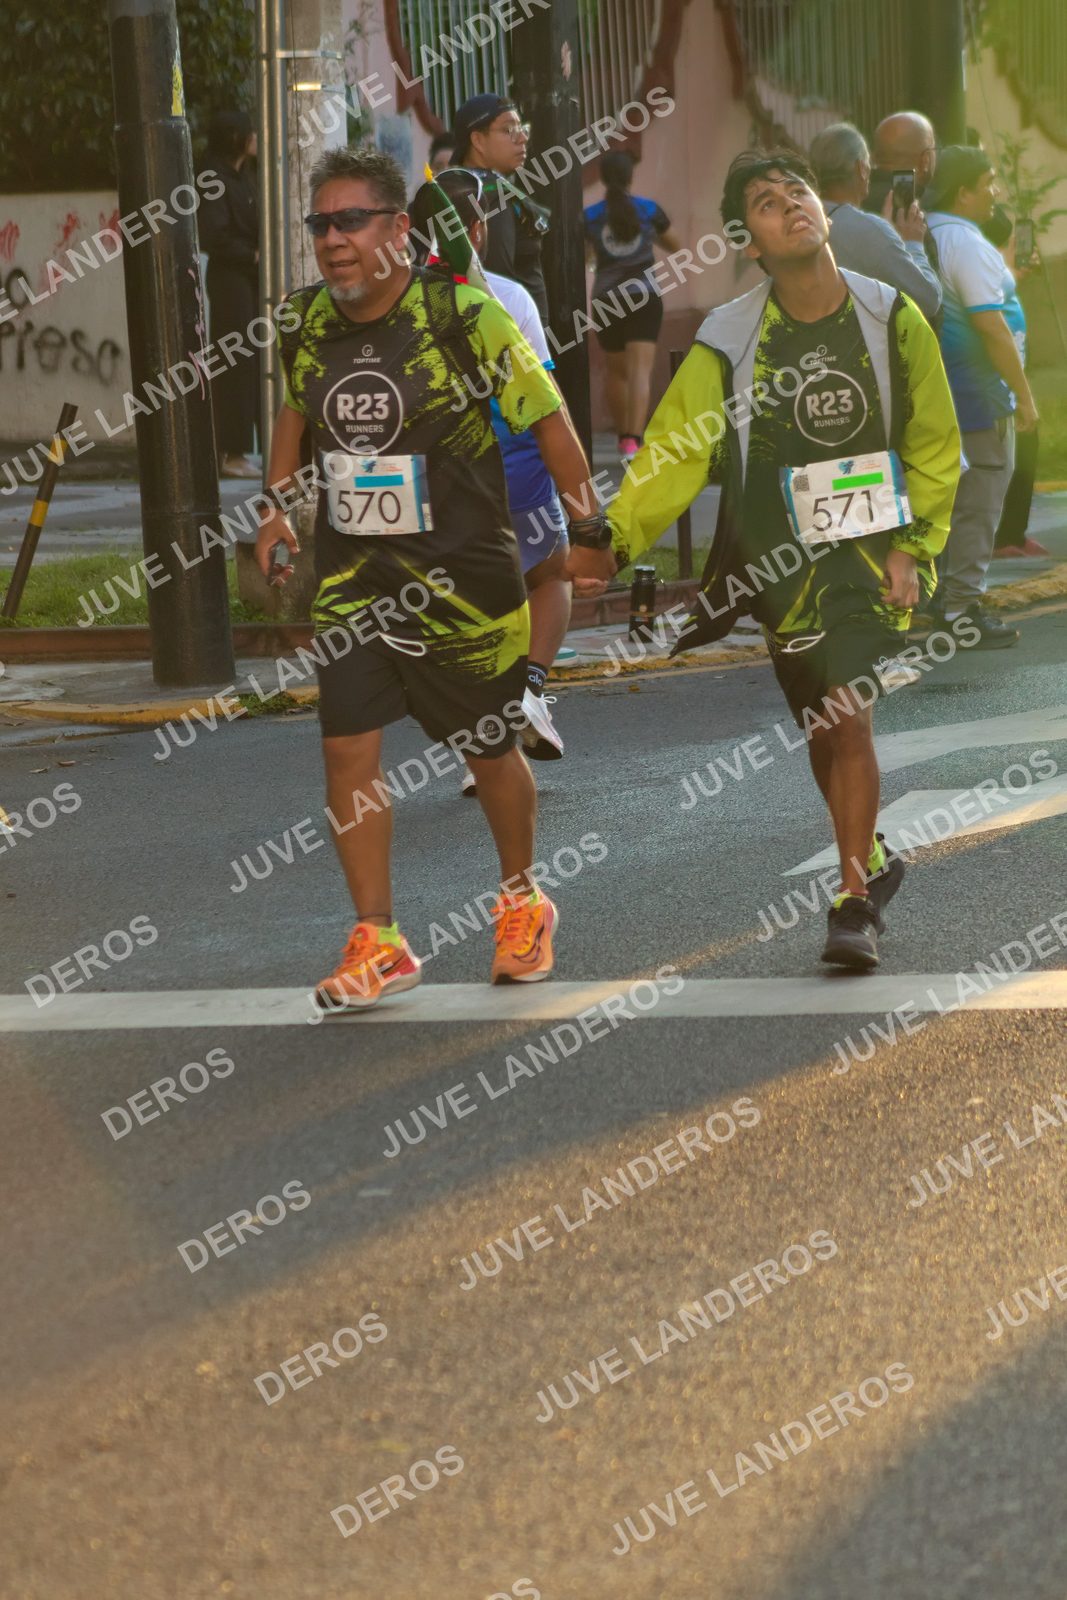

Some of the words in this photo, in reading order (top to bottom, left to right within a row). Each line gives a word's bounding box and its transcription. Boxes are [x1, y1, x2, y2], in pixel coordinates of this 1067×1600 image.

[336, 393, 389, 420] R23
[805, 389, 854, 419] R23
[345, 425, 384, 433] RUNNERS
[813, 416, 850, 428] RUNNERS
[337, 490, 402, 525] 570
[811, 490, 874, 532] 571
